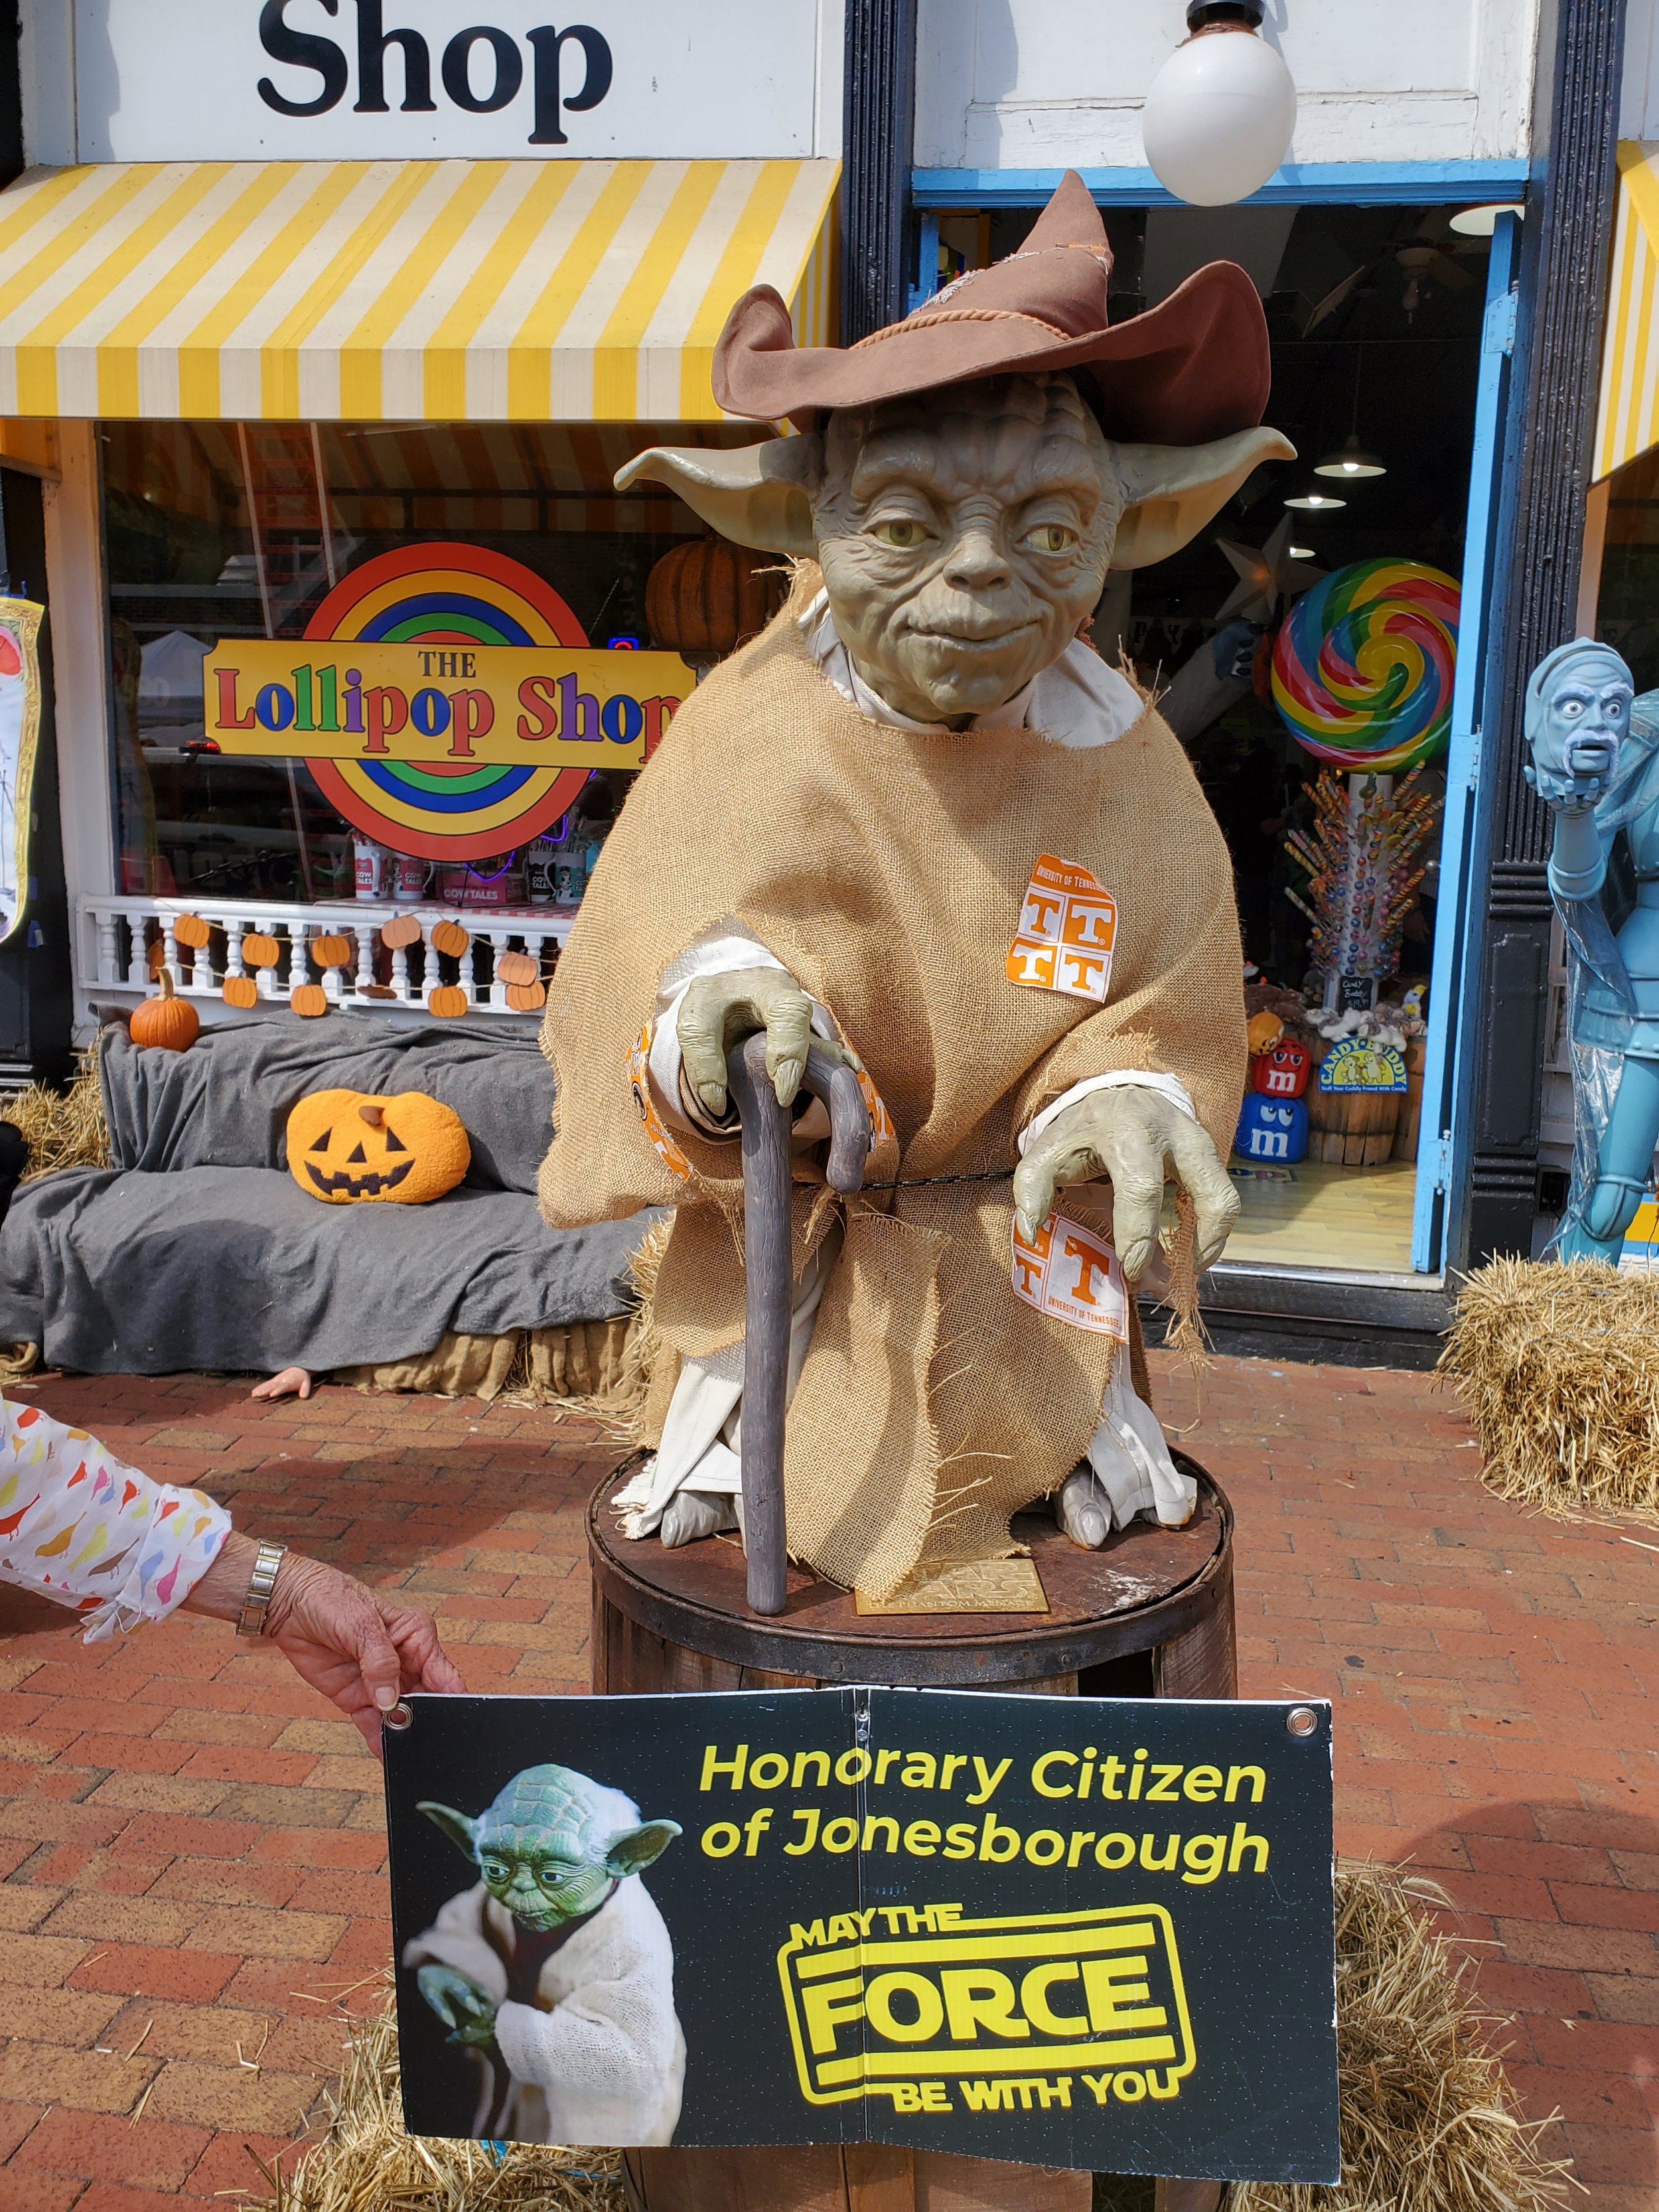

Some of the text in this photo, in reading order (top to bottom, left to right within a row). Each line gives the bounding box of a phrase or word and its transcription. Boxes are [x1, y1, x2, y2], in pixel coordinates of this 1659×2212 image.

[257, 0, 613, 145] Shop
[417, 650, 476, 678] THE
[214, 664, 494, 757] Lollipop
[444, 889, 469, 898] COW
[469, 891, 498, 900] TALES
[1037, 865, 1063, 883] UNIVERSITY
[1064, 875, 1072, 886] OF
[1027, 893, 1112, 942] T T
[1013, 944, 1104, 990] T T
[1267, 1069, 1296, 1092] m
[1321, 1039, 1359, 1084] CANDY
[1250, 1128, 1288, 1157] m
[1016, 1235, 1110, 1306] T T
[1048, 1295, 1119, 1327] UNIVERSITY OF TENNESSEE
[699, 1744, 1267, 1805] Honorary Citizen
[701, 1808, 1270, 1885] of Jonesborough
[790, 1903, 963, 1949] MAY THE
[802, 1955, 1167, 2055] FORCE
[891, 2068, 1181, 2112] BE WITH YOU
